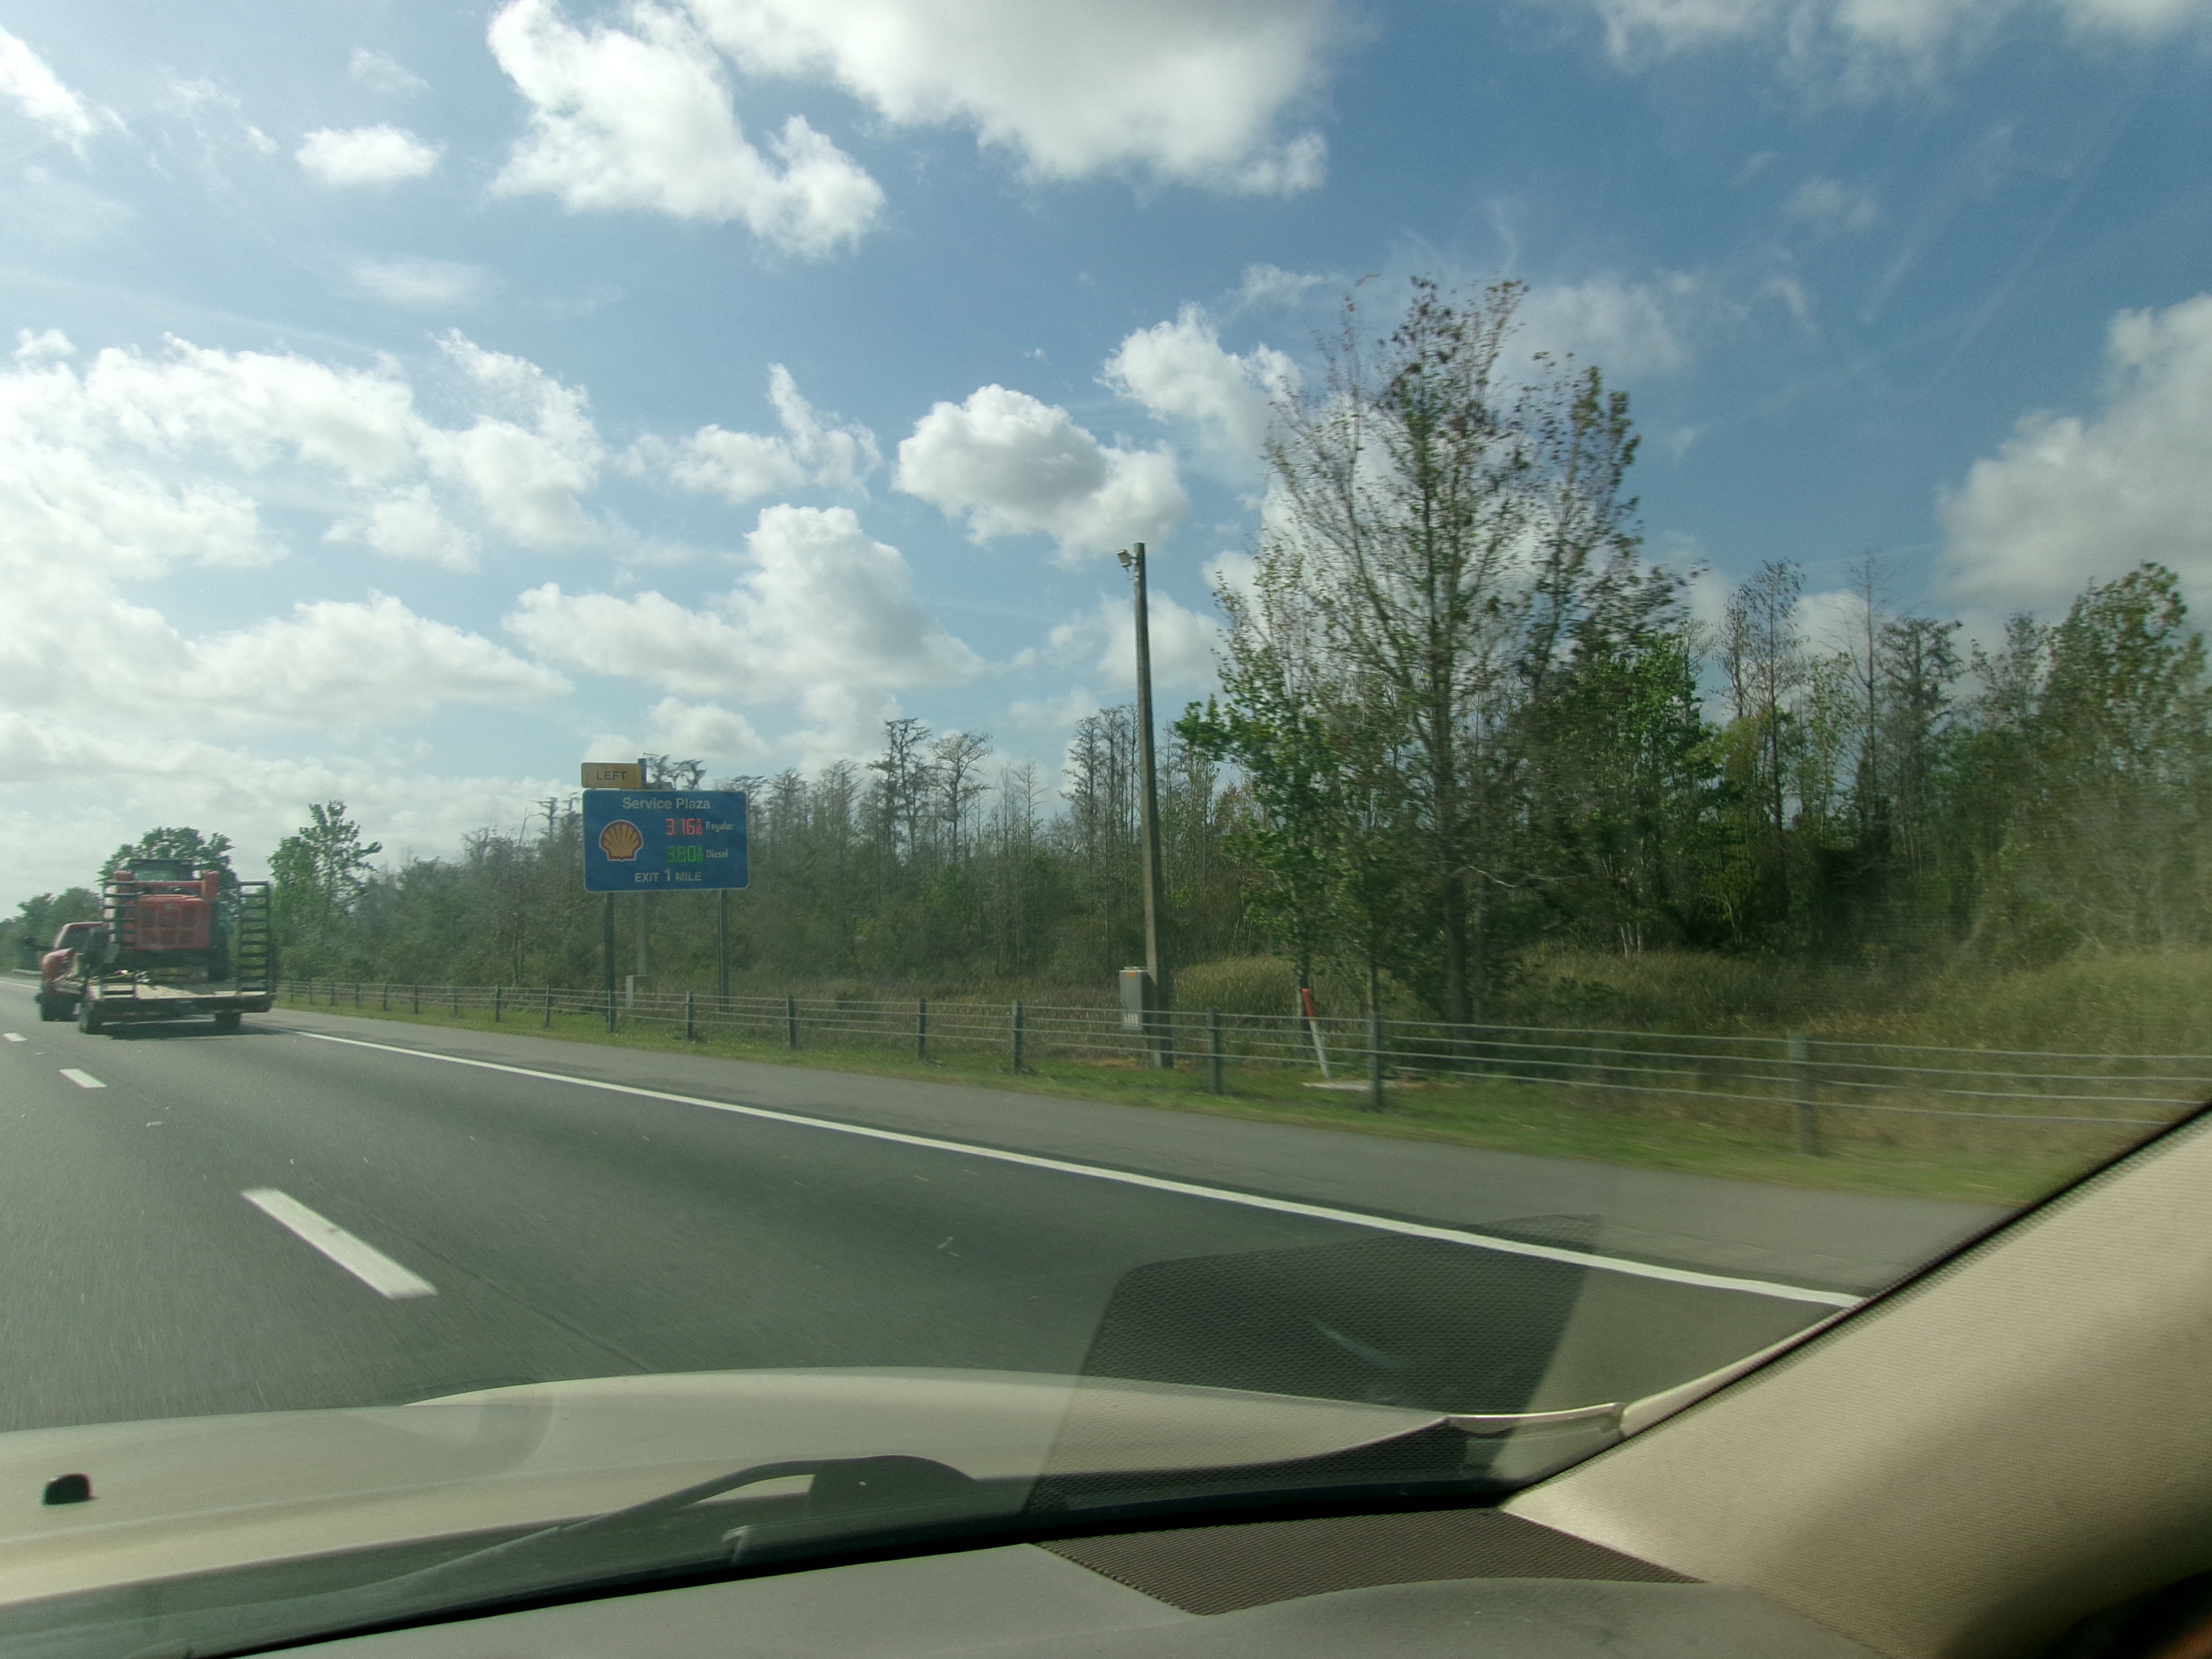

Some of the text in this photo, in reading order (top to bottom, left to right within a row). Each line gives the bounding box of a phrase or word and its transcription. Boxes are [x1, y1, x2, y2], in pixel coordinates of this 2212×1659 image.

[597, 771, 627, 780] LEFT
[623, 797, 710, 809] Service Plaza
[706, 821, 733, 832] Regular
[707, 849, 728, 858] Diesel
[635, 868, 702, 882] EXIT 1 MILE
